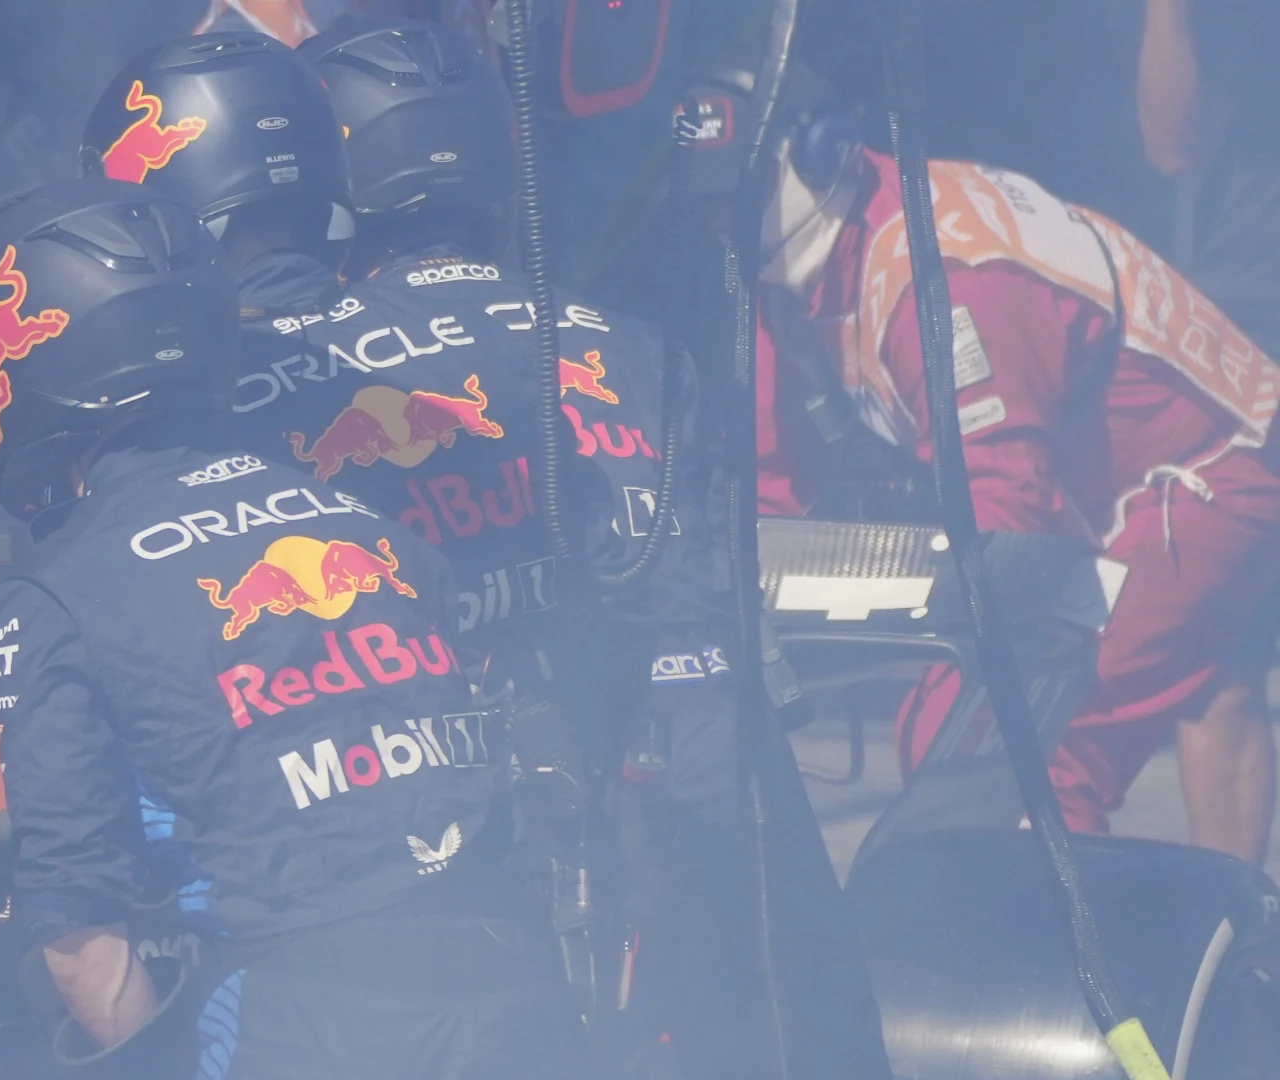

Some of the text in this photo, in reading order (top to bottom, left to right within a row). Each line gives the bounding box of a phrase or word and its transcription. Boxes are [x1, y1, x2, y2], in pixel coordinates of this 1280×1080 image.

[406, 260, 502, 286] sparco
[225, 315, 476, 413] ORACLE
[178, 454, 267, 486] sparco
[130, 487, 382, 560] ORACLE
[218, 631, 352, 728] Red
[277, 716, 451, 809] Mobil
